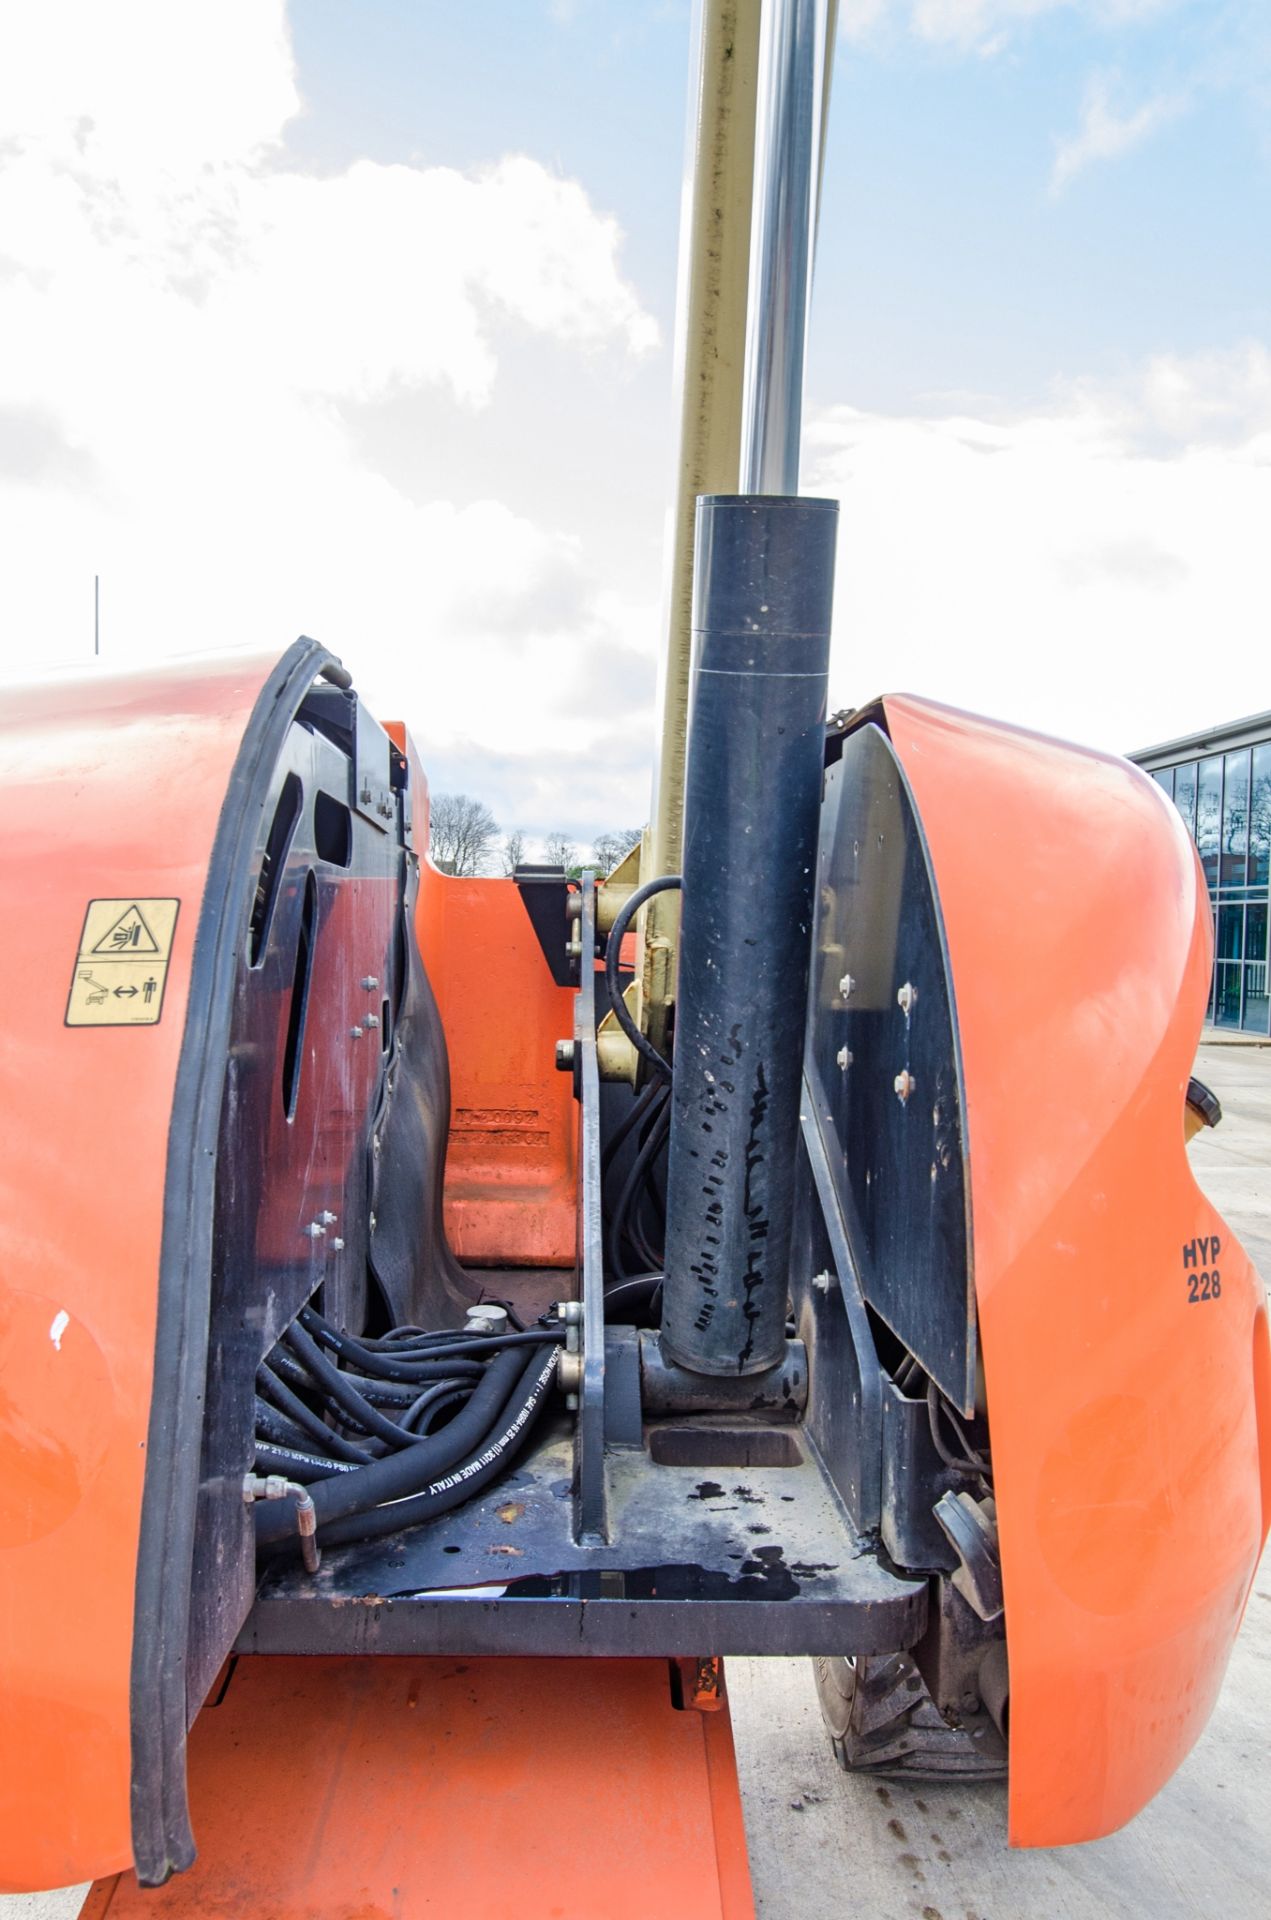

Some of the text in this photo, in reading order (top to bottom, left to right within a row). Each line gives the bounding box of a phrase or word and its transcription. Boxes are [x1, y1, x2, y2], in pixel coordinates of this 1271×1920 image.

[1183, 1236, 1221, 1269] HYP
[1187, 1270, 1221, 1303] 228
[539, 1366, 552, 1386] HOSE
[525, 1396, 537, 1411] SAE
[451, 1472, 463, 1484] IN
[460, 1460, 483, 1479] MADE
[429, 1477, 455, 1495] ITALY
